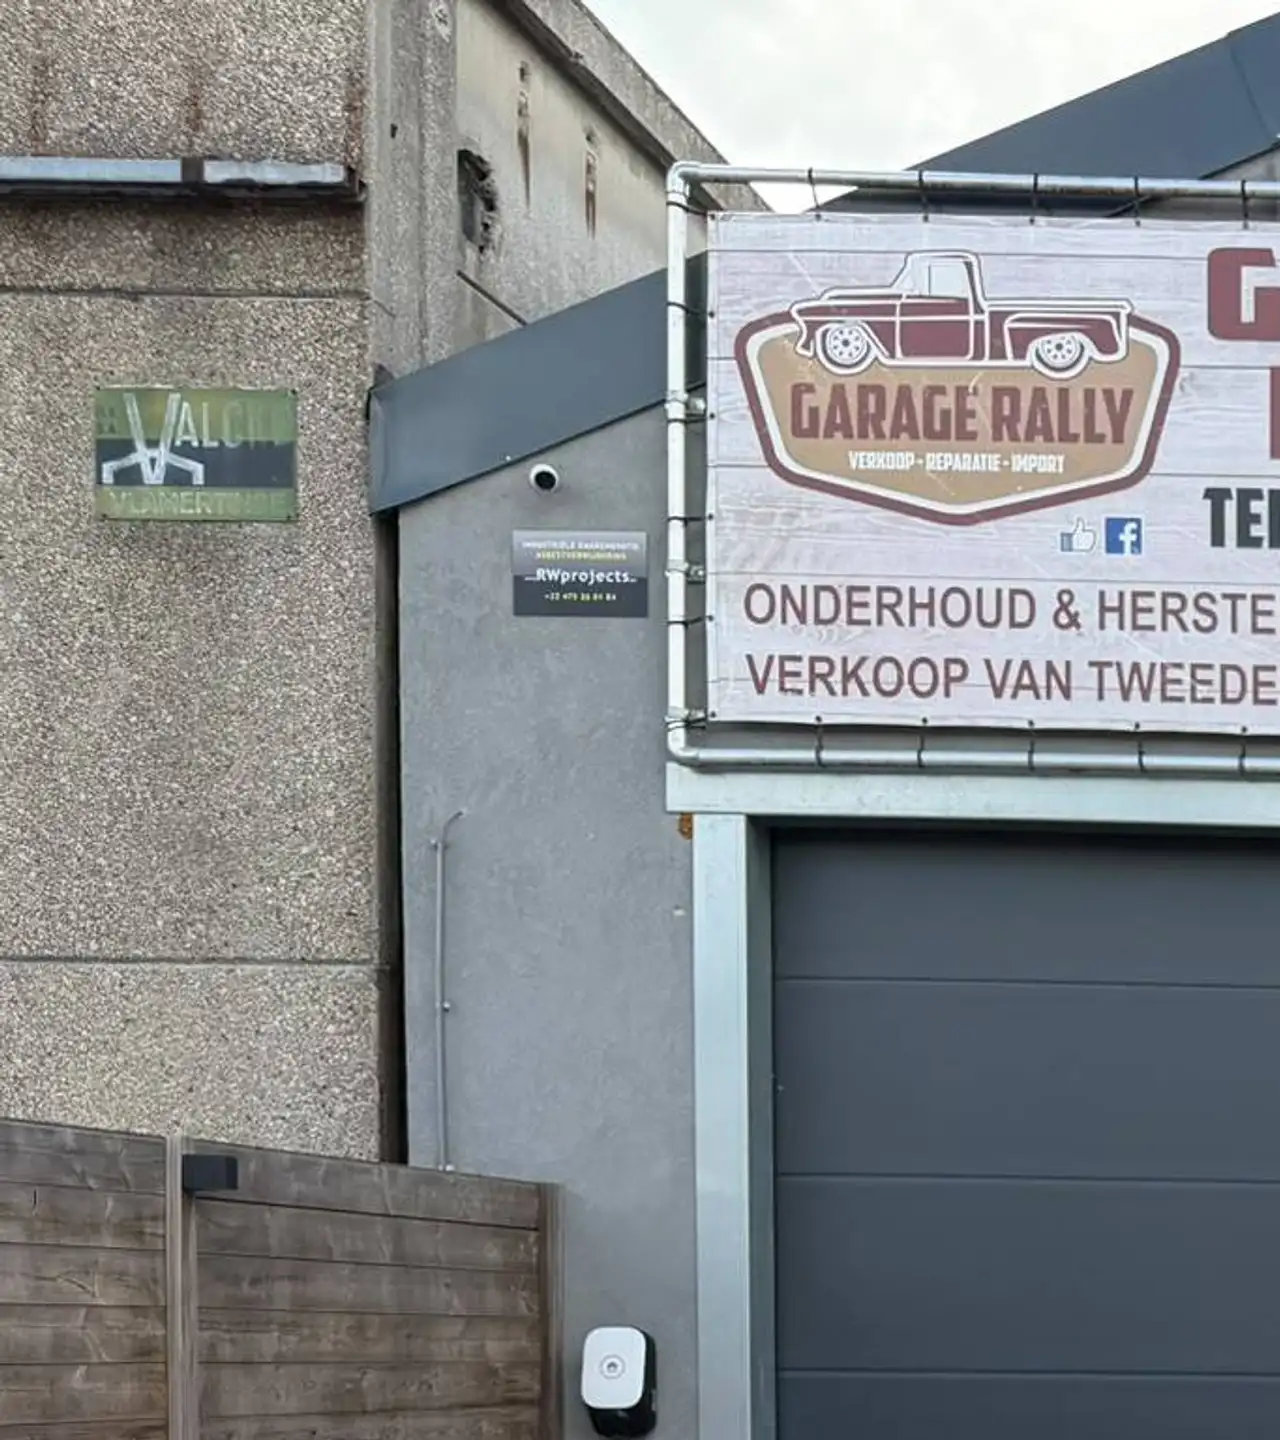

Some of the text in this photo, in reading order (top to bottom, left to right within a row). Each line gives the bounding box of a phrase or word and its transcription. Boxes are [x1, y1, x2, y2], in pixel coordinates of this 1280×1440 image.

[790, 382, 1134, 444] GARAGE RALLY
[848, 451, 915, 470] VERKOOP
[926, 452, 1001, 472] REPARATIE
[1011, 453, 1064, 473] IMPORT
[744, 584, 1035, 629] ONDERHOUD
[1053, 589, 1081, 630] &
[745, 654, 969, 698] VERKOOP
[984, 659, 1072, 700] VAN
